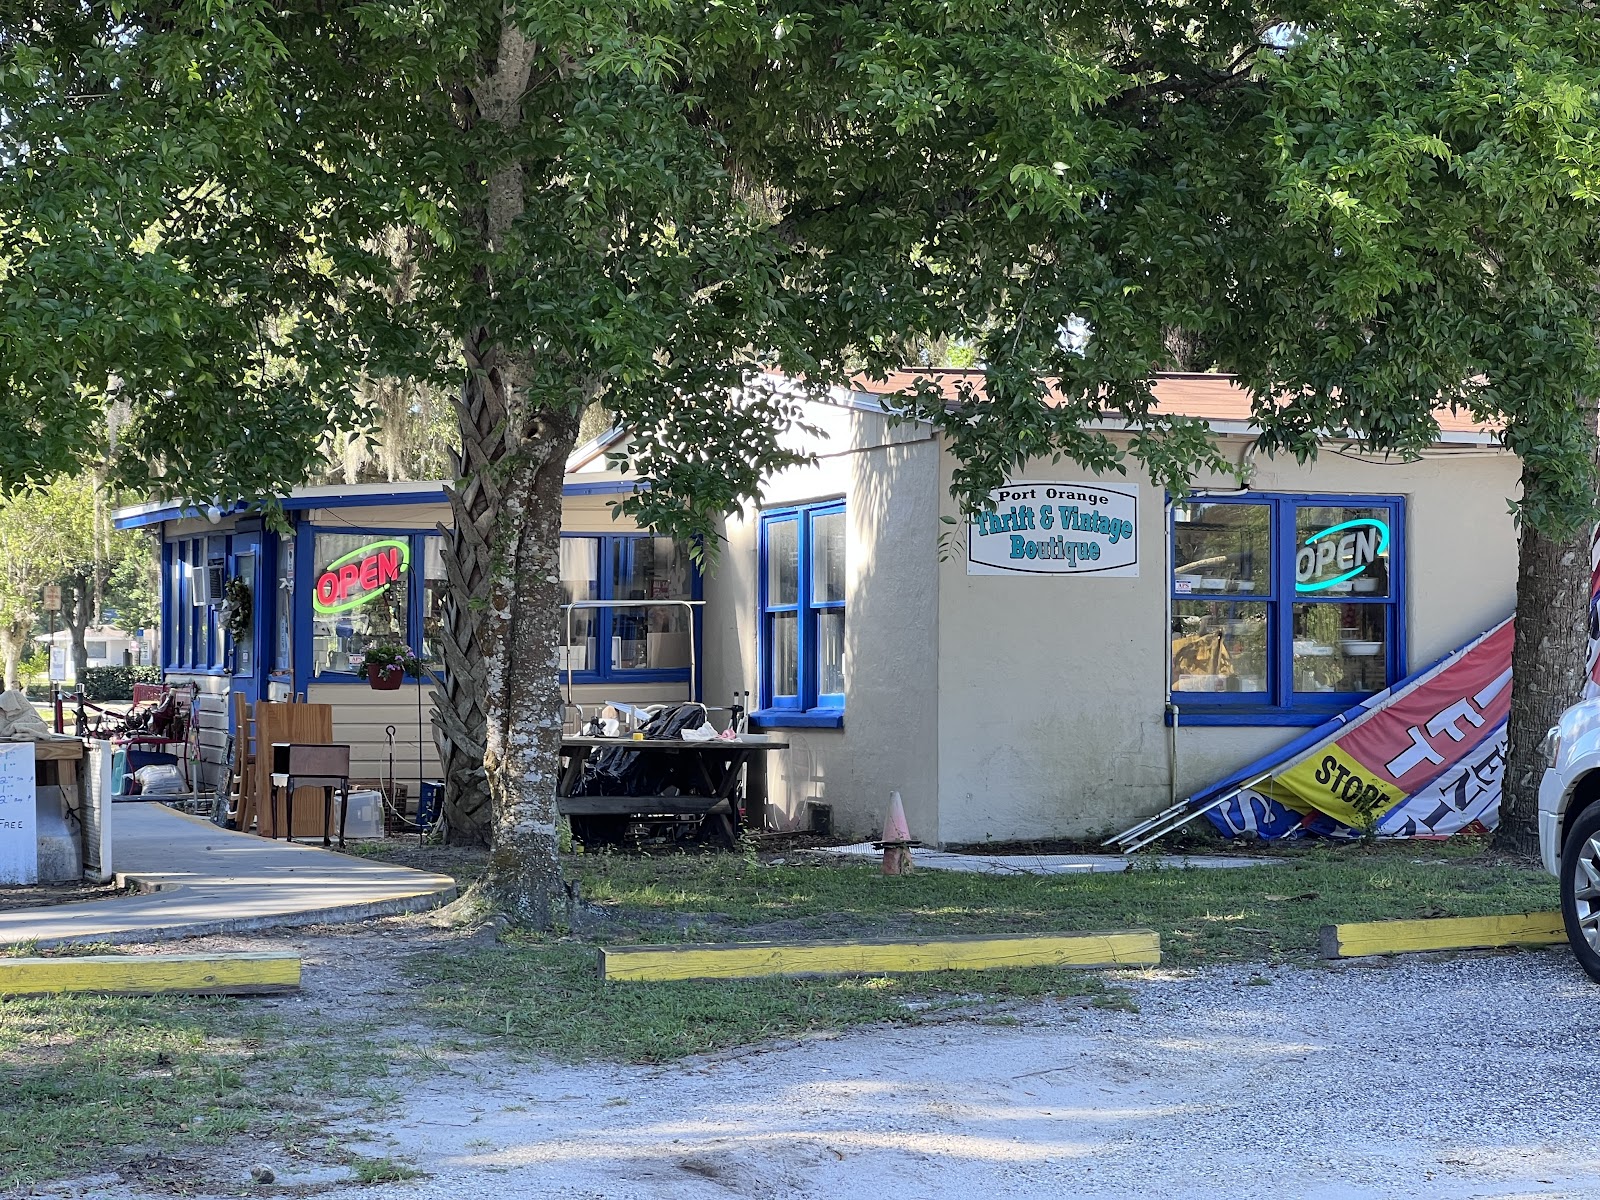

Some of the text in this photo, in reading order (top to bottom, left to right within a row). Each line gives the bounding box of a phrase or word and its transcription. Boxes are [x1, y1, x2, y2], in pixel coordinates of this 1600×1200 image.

[999, 488, 1109, 505] Port Orange
[976, 505, 1133, 544] Thrift & Vintage
[1010, 535, 1101, 567] Boutique
[317, 547, 399, 606] OPEN
[1295, 528, 1377, 582] OPEN
[1384, 666, 1513, 779] IFT
[1315, 755, 1391, 815] STORE
